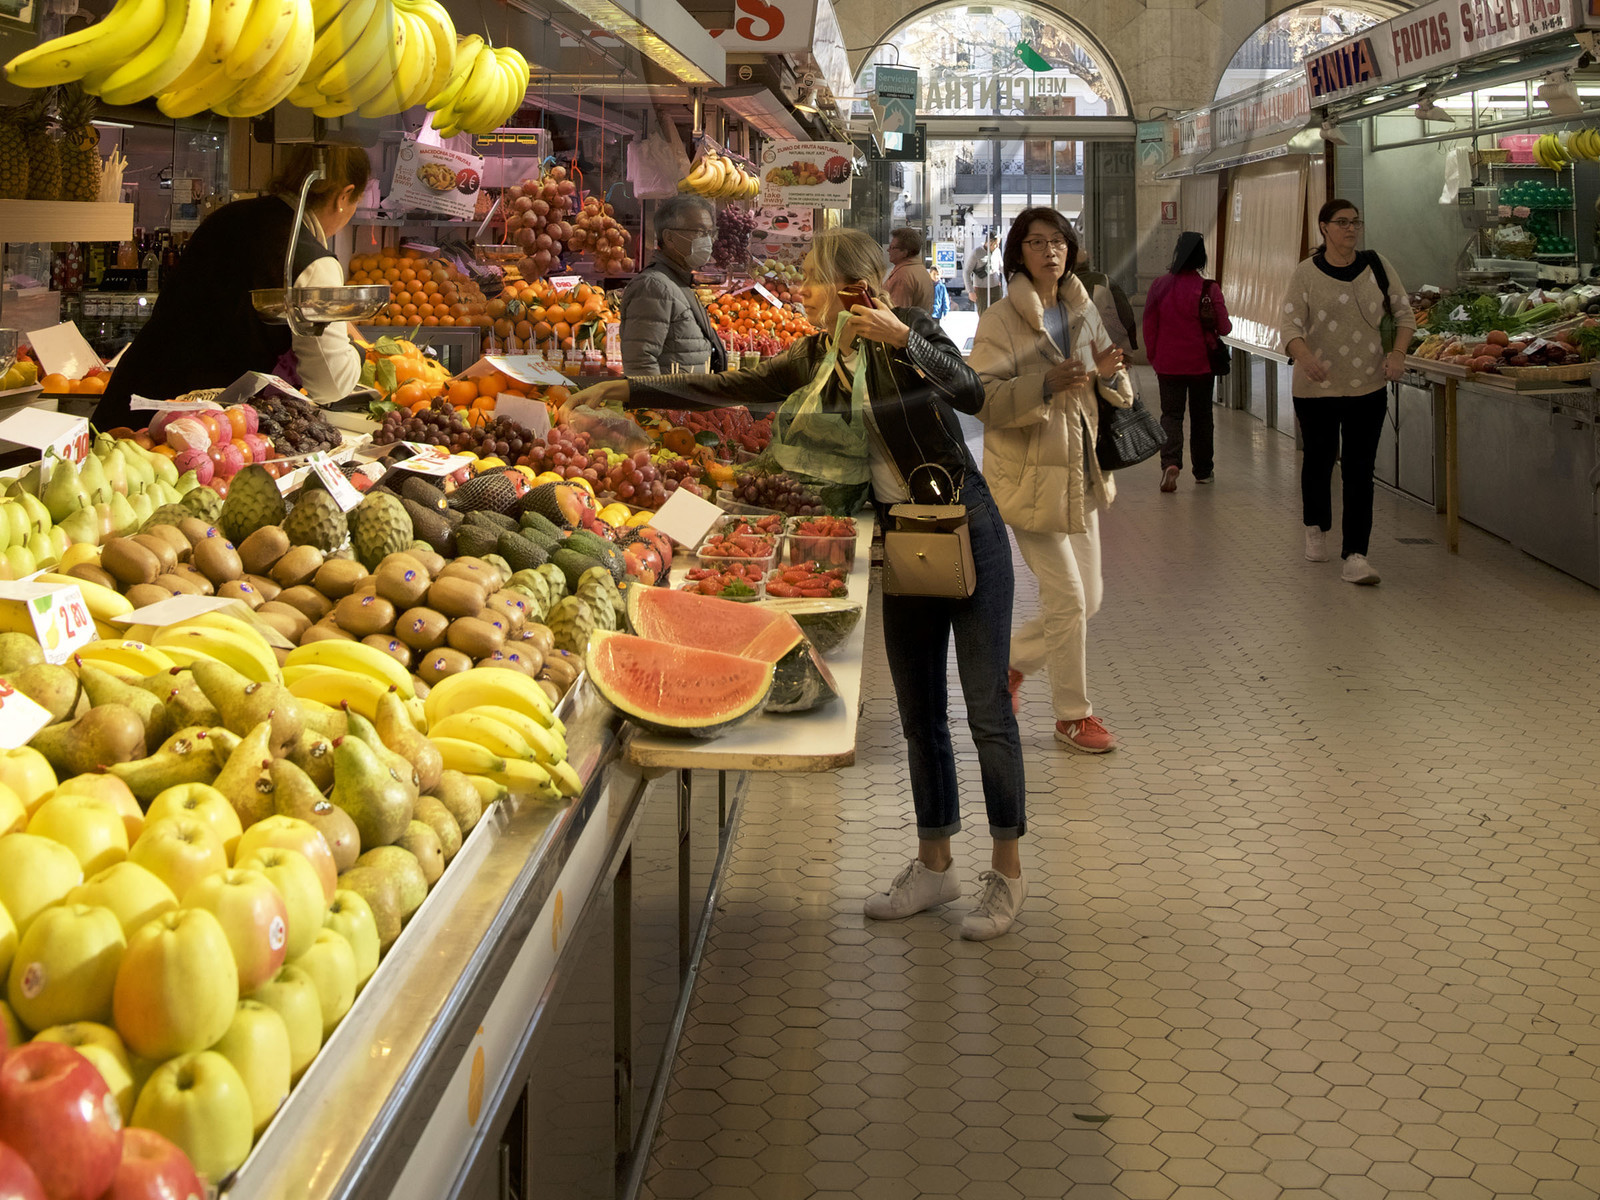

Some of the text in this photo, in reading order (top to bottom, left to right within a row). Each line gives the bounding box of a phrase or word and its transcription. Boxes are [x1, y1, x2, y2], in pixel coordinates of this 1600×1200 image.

[1307, 38, 1374, 98] FINITA
[1392, 11, 1452, 66] FRUTAS
[878, 73, 910, 84] Servicio
[878, 83, 915, 93] domicilio
[777, 144, 793, 154] ZUMO
[817, 144, 839, 155] NATURAL
[420, 149, 449, 158] MACEDONIA
[455, 155, 472, 167] FRUTAS
[826, 161, 849, 180] 1,50 €
[395, 173, 412, 183] take
[459, 172, 477, 191] 2 €
[394, 179, 414, 189] away
[763, 197, 784, 205] away
